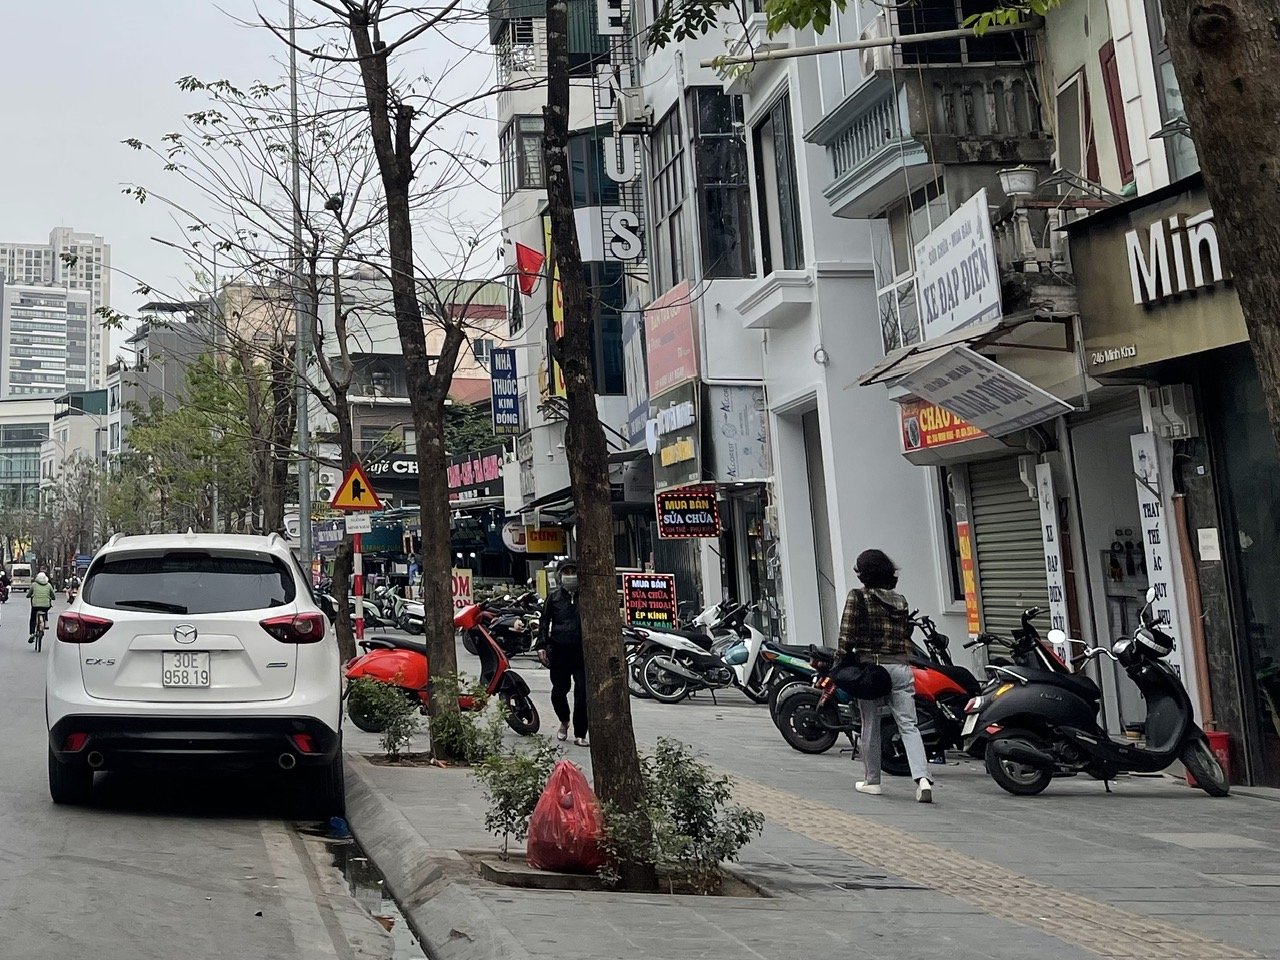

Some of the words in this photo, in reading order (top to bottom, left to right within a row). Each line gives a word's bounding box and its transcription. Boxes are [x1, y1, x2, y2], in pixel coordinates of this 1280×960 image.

[1125, 208, 1234, 304] Min
[923, 282, 939, 325] XE
[938, 267, 960, 321] ĐẠP
[960, 239, 990, 304] ĐIỆN
[495, 350, 512, 370] NHÀ
[1092, 352, 1104, 365] 246
[1104, 348, 1120, 362] Minh
[1120, 344, 1136, 359] Khai
[493, 372, 517, 396] THUỐC
[975, 372, 1034, 406] ĐIỆN
[498, 398, 514, 409] KIM
[953, 388, 1003, 417] ĐẠP
[392, 460, 420, 474] CH
[665, 500, 688, 510] MUA
[689, 497, 710, 510] BÁN
[1142, 502, 1160, 518] THAY
[664, 511, 684, 524] SỬA
[686, 512, 714, 524] CHỮA
[1046, 525, 1054, 542] XE
[1148, 522, 1161, 545] THẾ
[632, 580, 650, 588] MUA
[651, 579, 666, 588] BÁN
[632, 589, 646, 598] SỬA
[648, 590, 668, 599] CHỮA
[1154, 583, 1168, 602] QUY
[636, 610, 646, 619] ÉP
[648, 611, 668, 620] KÍNH
[86, 658, 116, 666] CX-5
[174, 653, 198, 668] 30E
[164, 670, 208, 686] 958.19
